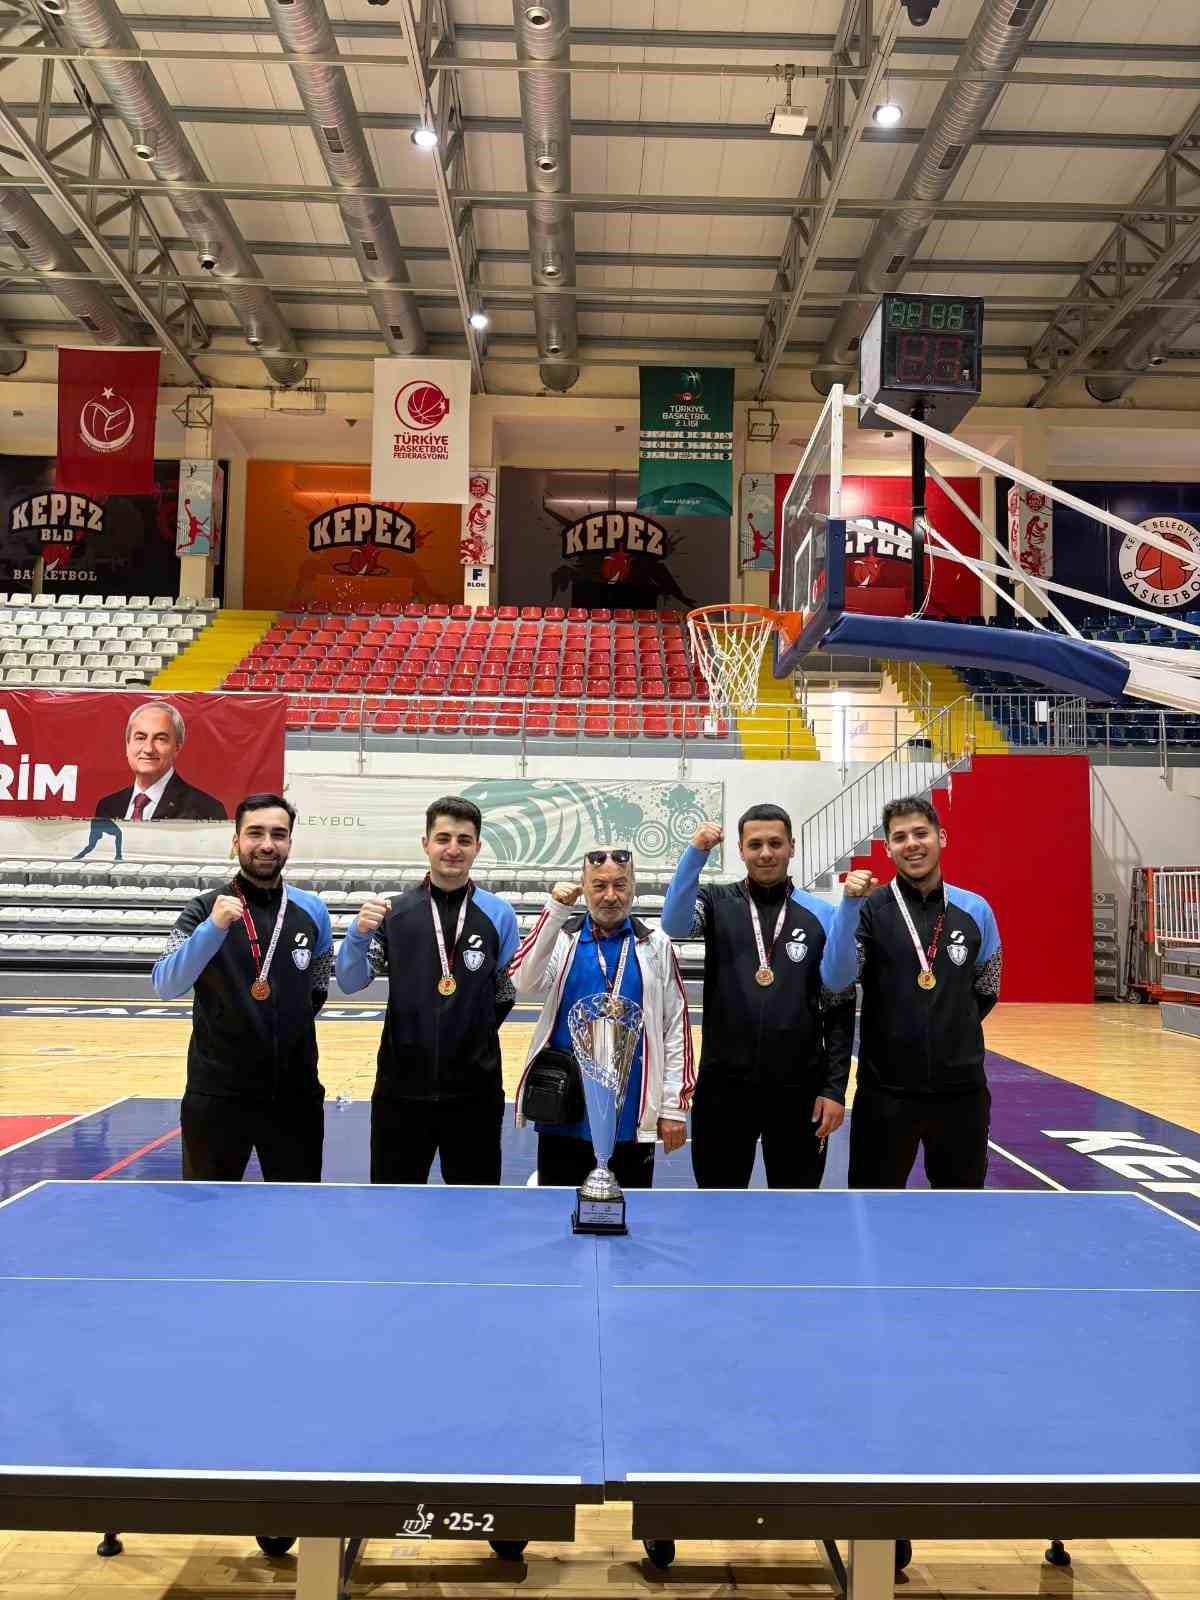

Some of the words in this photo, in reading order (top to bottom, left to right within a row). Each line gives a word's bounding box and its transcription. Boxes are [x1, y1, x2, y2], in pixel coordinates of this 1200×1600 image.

[394, 431, 449, 446] TÜRKİYE
[393, 445, 449, 454] BASKETBOL
[393, 452, 449, 461] FEDERASYONU
[12, 493, 104, 531] KEPEZ
[312, 505, 414, 550] KEPEZ
[565, 513, 666, 555] KEPEZ
[41, 528, 74, 542] BLD
[13, 568, 97, 582] BAETBOL
[472, 568, 483, 581] F
